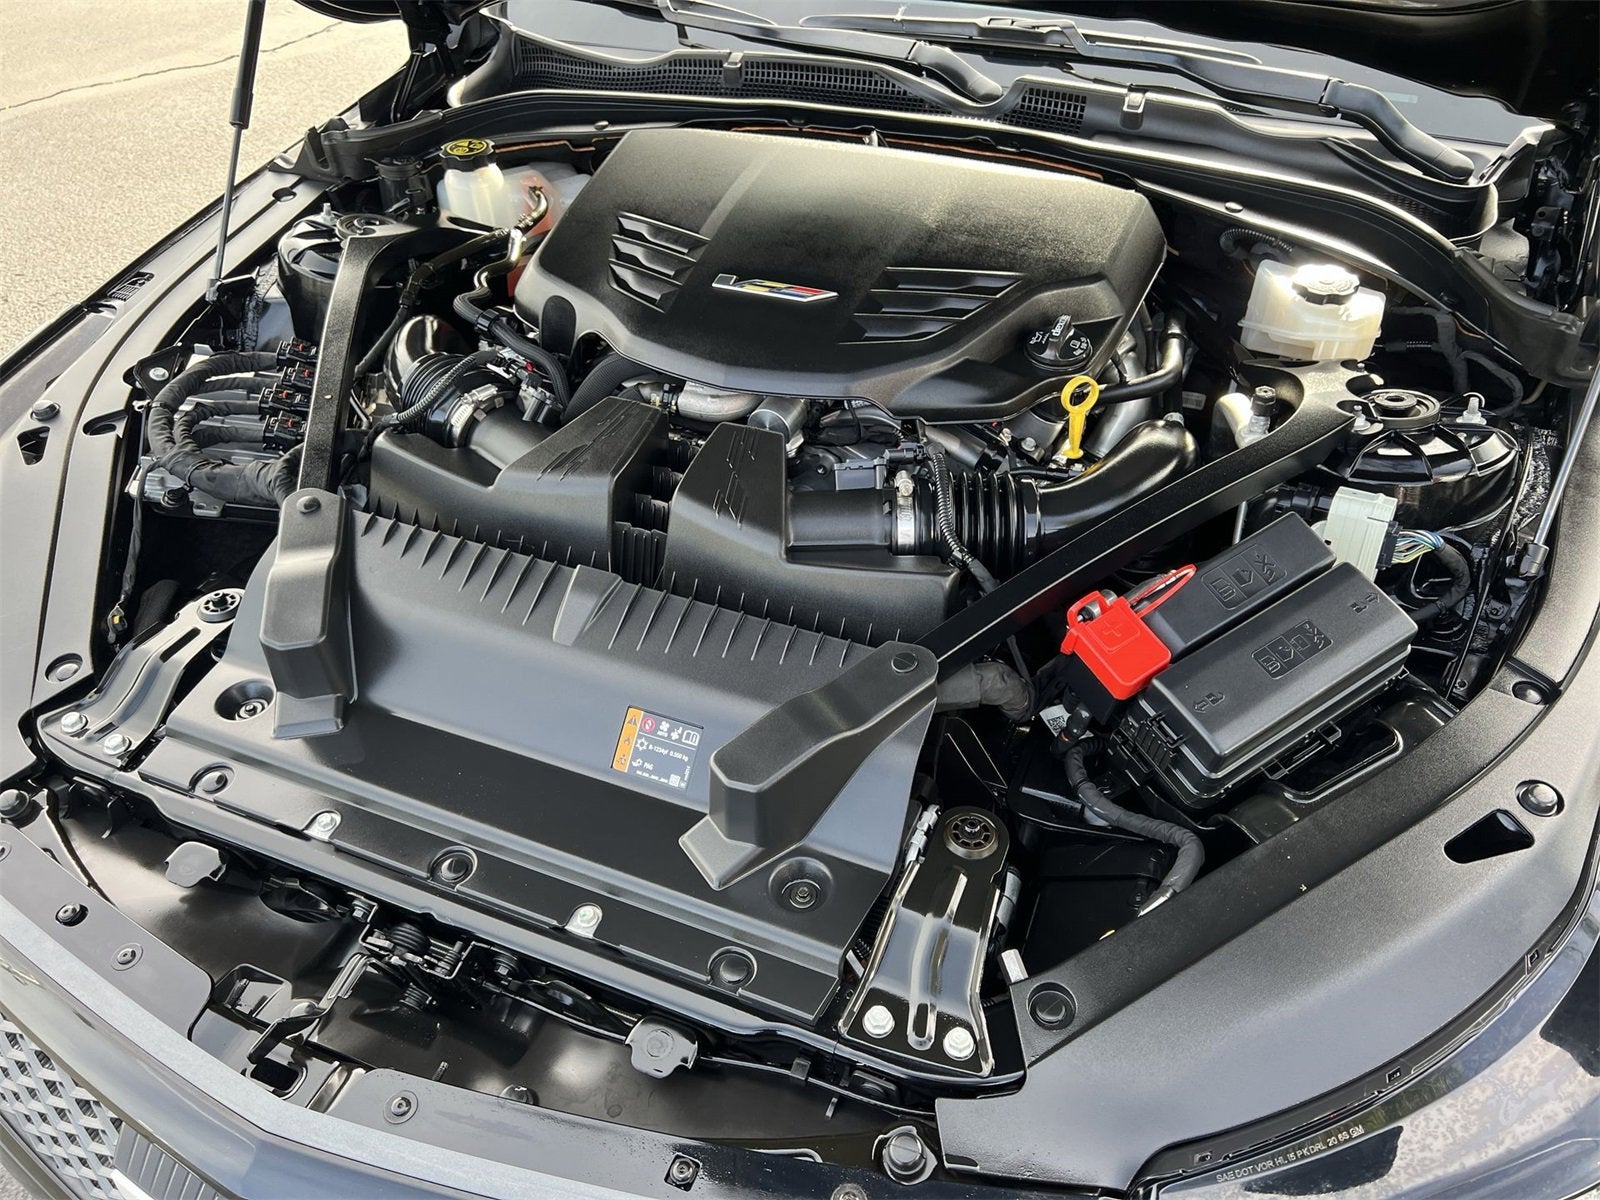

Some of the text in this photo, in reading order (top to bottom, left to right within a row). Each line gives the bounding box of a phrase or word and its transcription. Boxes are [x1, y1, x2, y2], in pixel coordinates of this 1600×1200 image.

[1216, 1170, 1235, 1182] SAE
[1235, 1165, 1254, 1178] DOT
[1254, 1160, 1275, 1172] VOR
[1327, 1136, 1338, 1147] 20
[1349, 1124, 1365, 1138] GM
